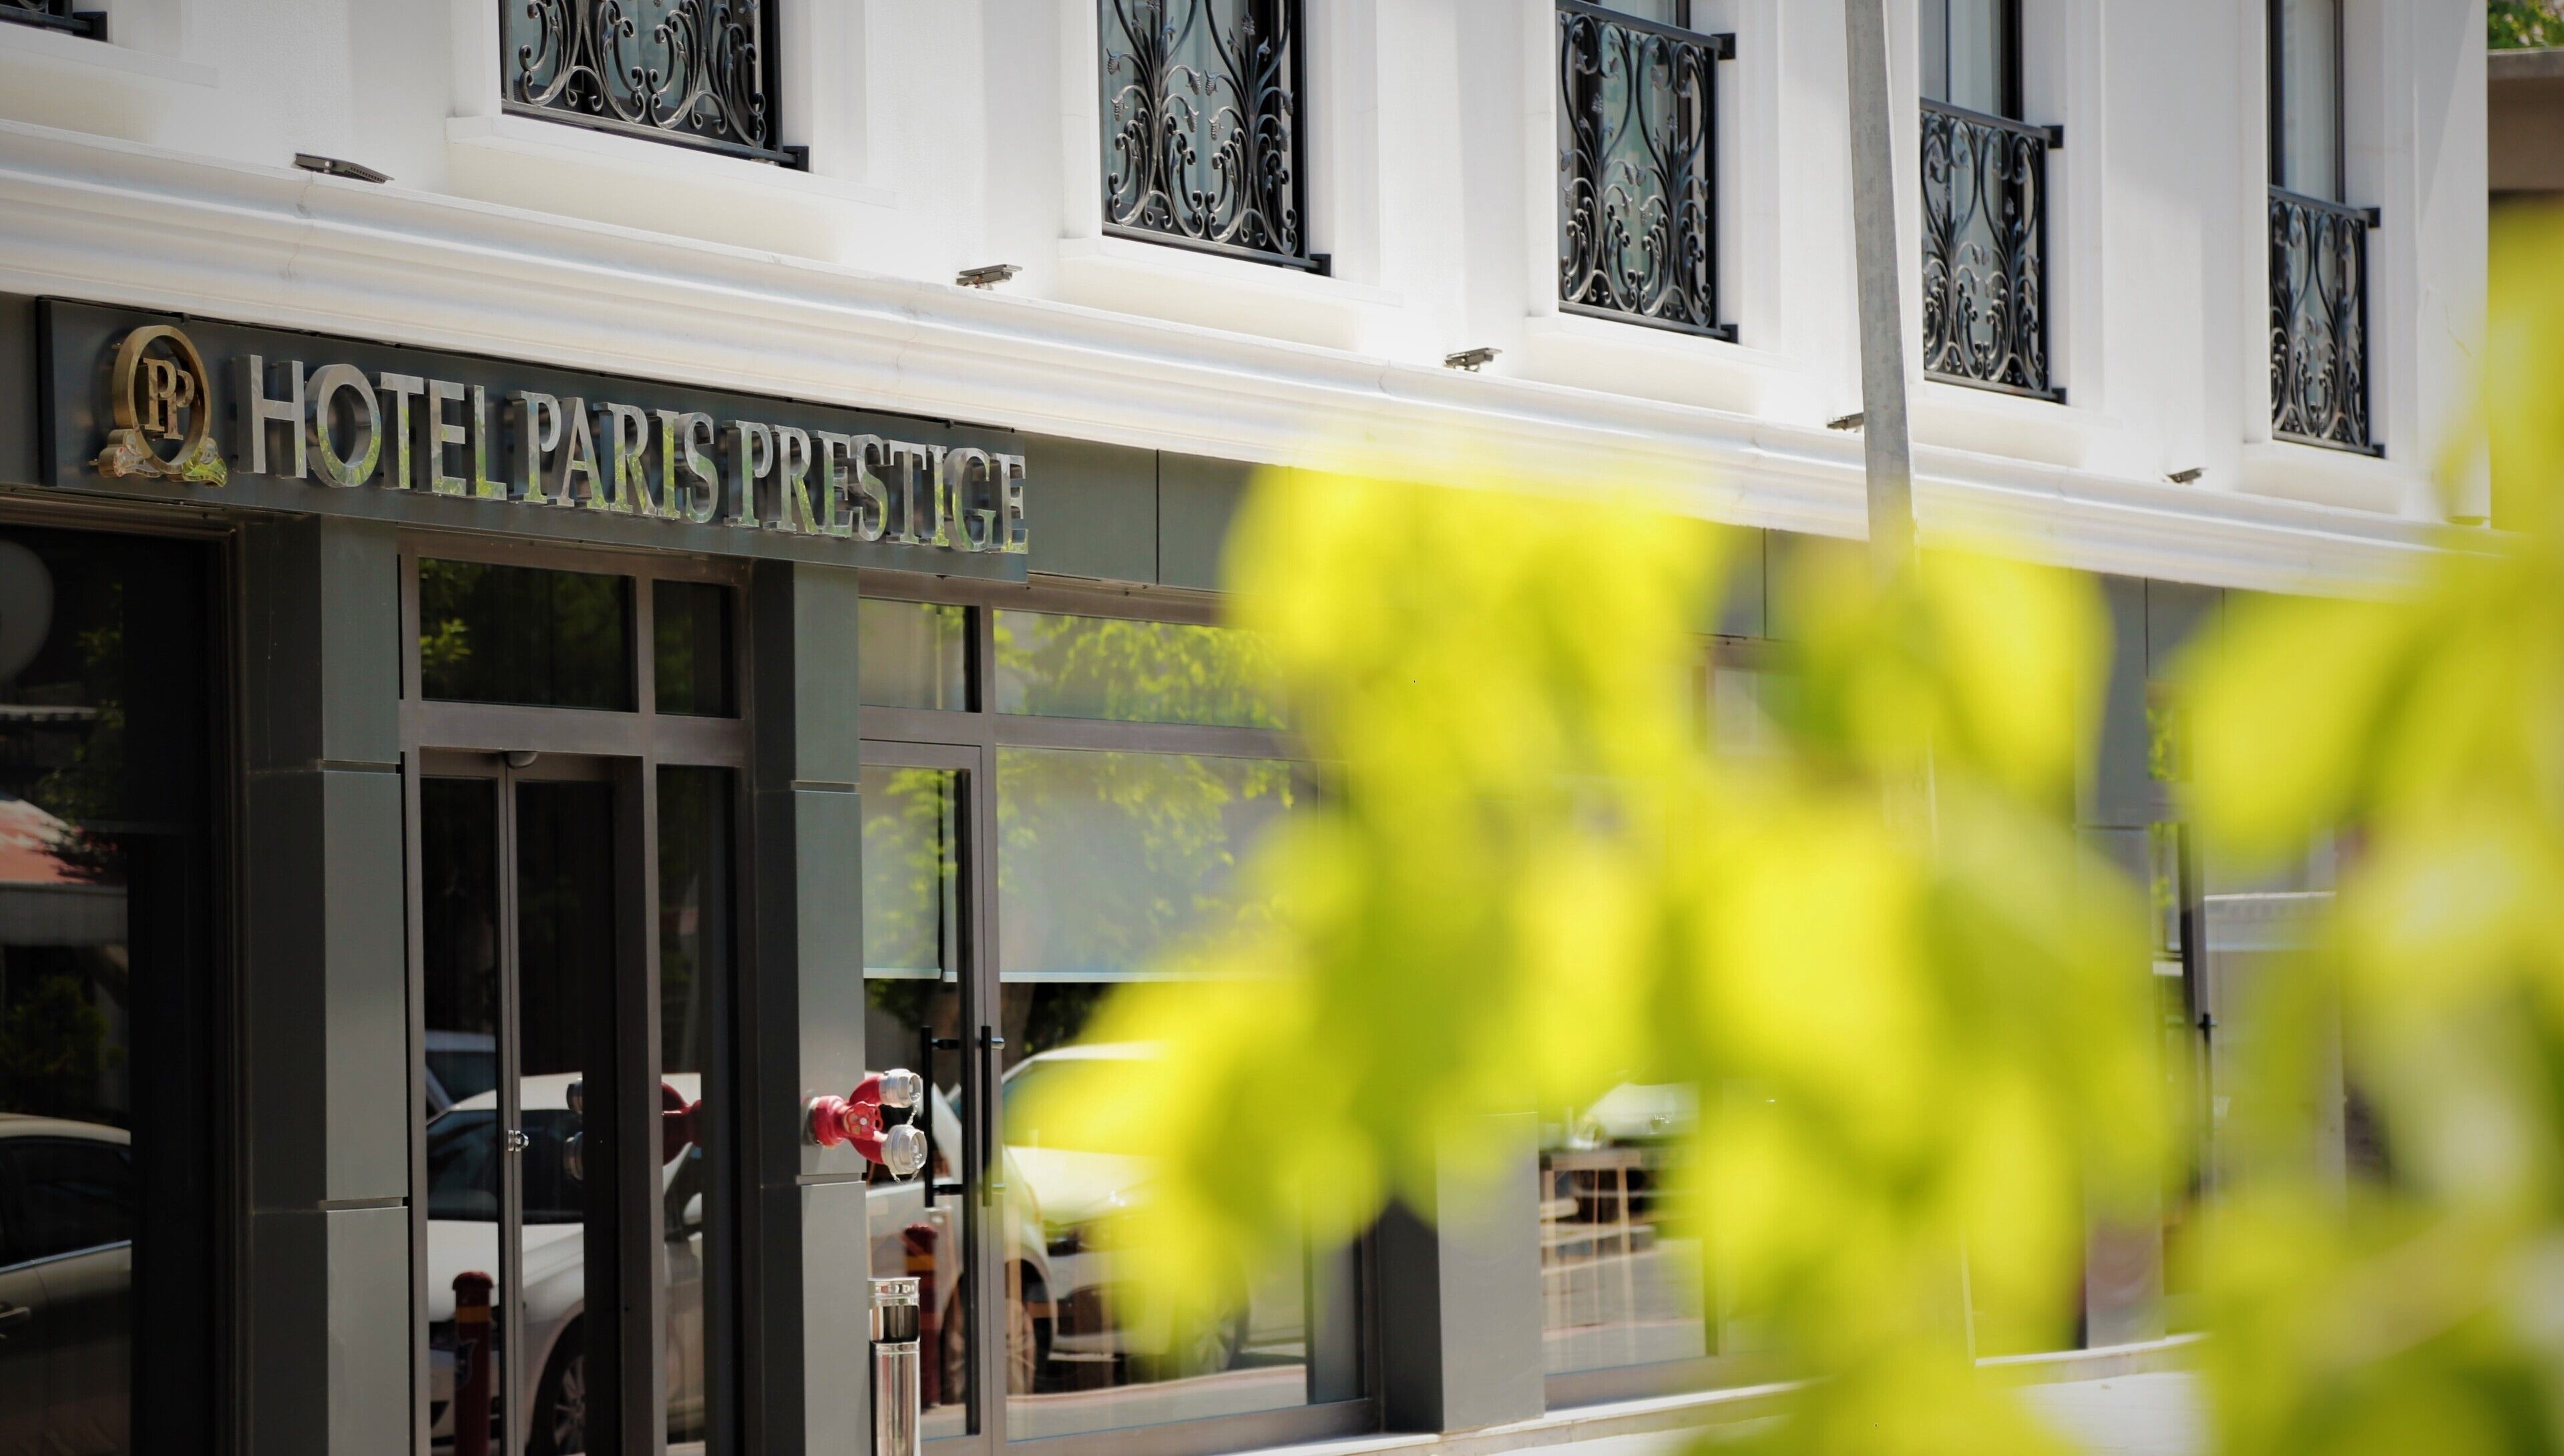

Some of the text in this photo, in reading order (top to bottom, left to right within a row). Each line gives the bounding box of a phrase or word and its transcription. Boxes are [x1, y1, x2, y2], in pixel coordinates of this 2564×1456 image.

[236, 354, 1029, 554] HOTEL PARIS PRESTIGE
